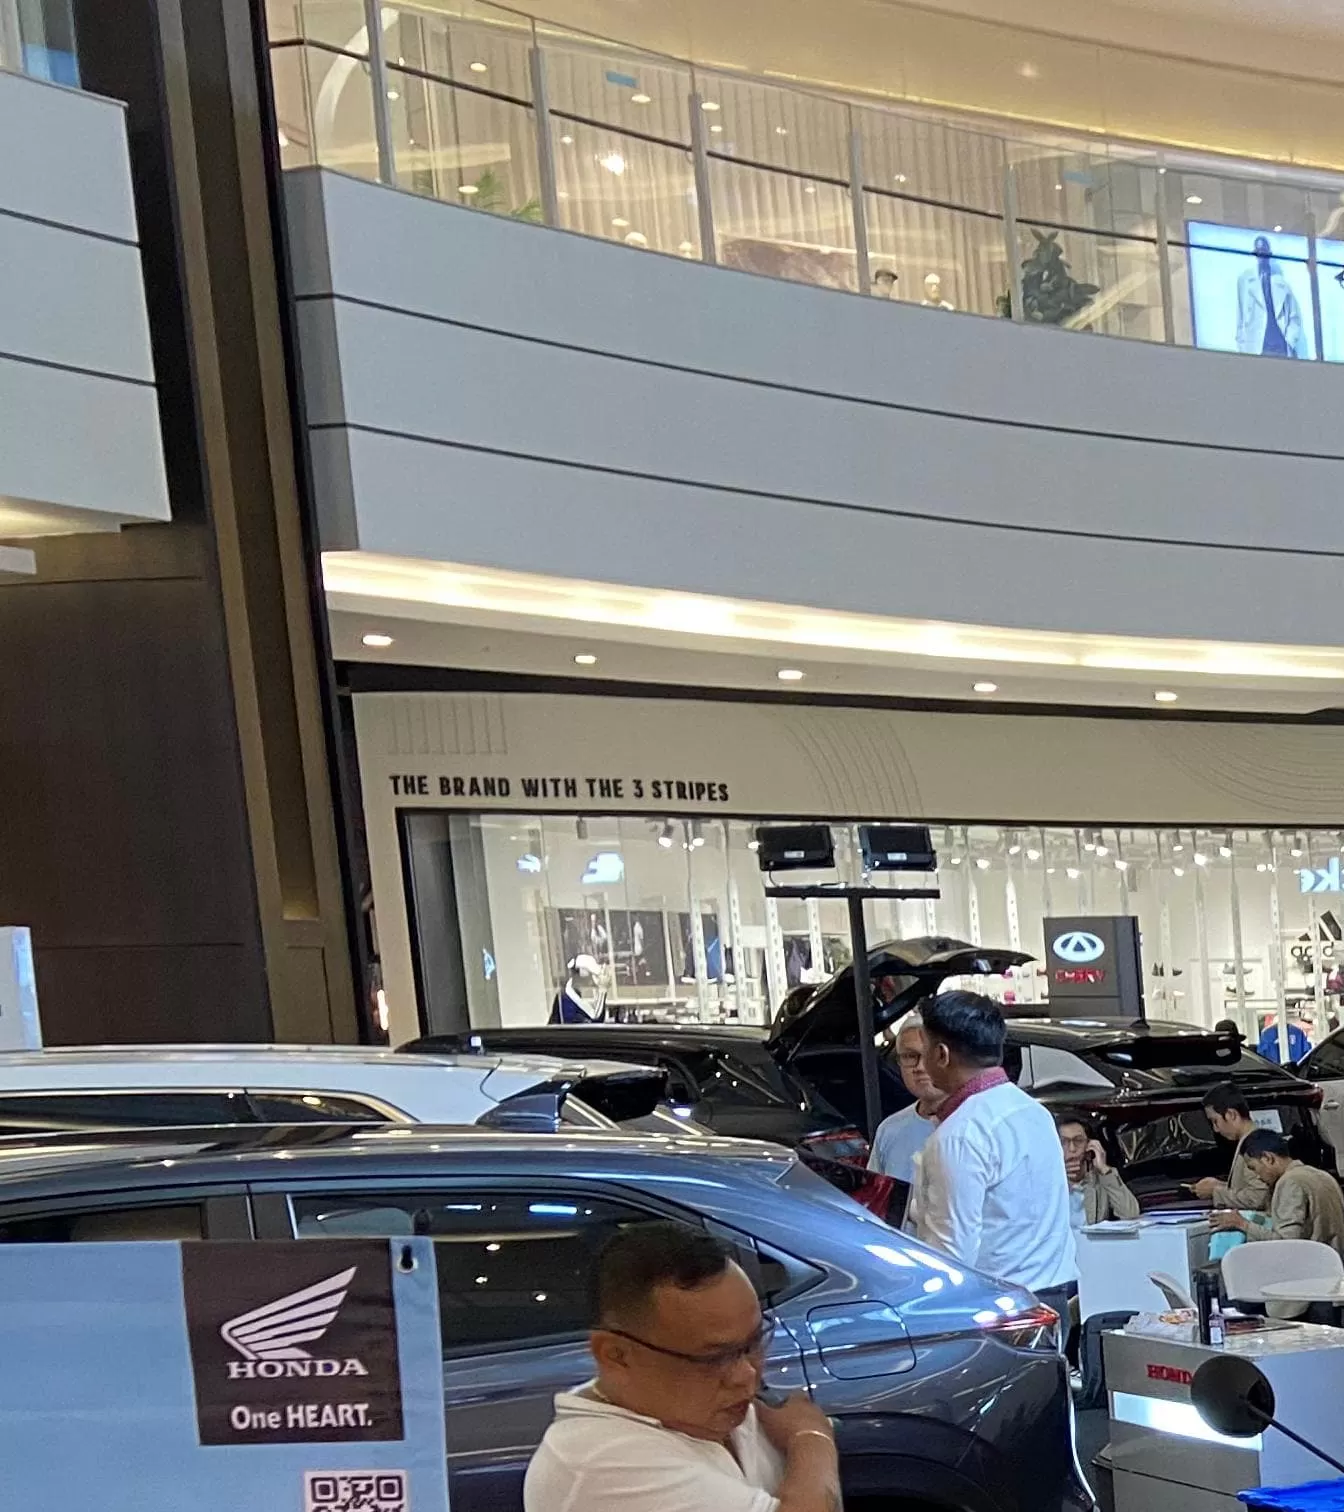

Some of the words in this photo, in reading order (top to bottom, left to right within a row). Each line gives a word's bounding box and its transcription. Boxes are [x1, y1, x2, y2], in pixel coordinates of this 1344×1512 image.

[390, 775, 428, 796] THE
[440, 776, 511, 798] BRAND
[521, 778, 577, 798] WITH
[585, 778, 624, 799] THE
[633, 778, 644, 799] 3
[651, 780, 729, 802] STRIPES
[227, 1360, 368, 1379] HONDA
[230, 1407, 282, 1429] One
[286, 1405, 373, 1429] HEART.
